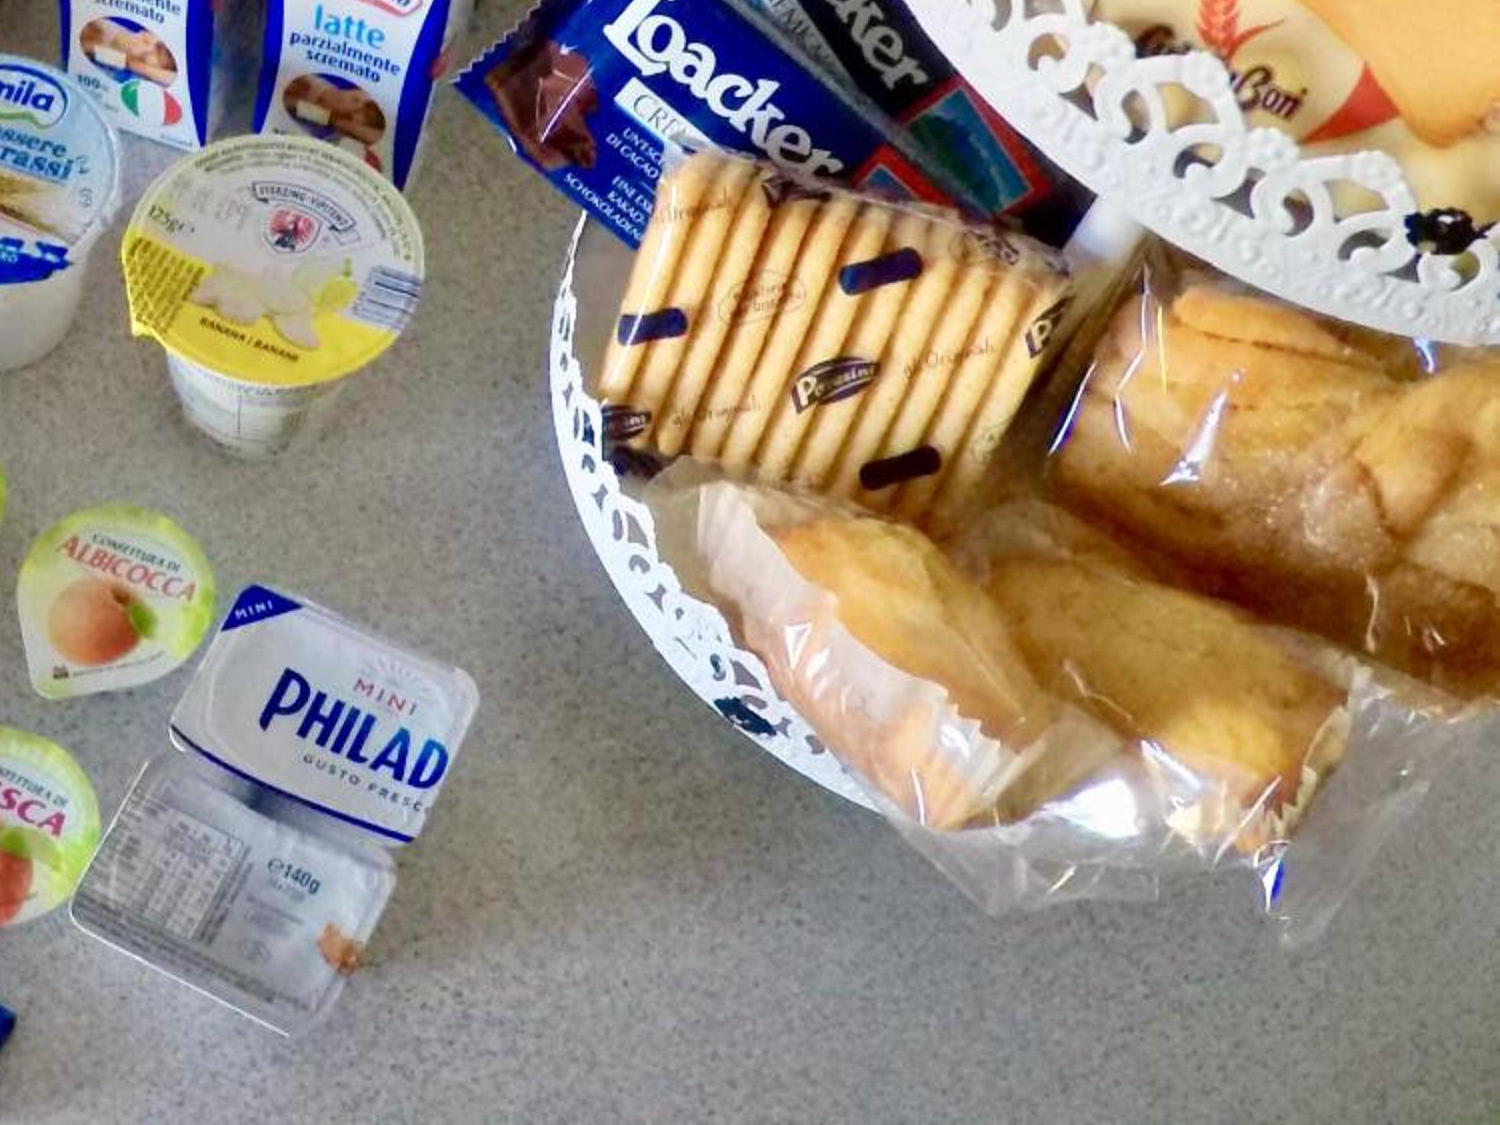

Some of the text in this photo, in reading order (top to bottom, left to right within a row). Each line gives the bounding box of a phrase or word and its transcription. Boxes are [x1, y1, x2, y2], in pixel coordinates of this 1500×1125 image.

[313, 2, 386, 49] latte
[289, 31, 402, 77] parzialmente
[306, 47, 382, 84] scremato
[605, 133, 659, 179] DI CACAO
[198, 316, 246, 344] BANANA
[57, 533, 197, 604] ALBICOCCA
[91, 532, 181, 573] CONFETTURA DI
[233, 597, 276, 621] MINI
[353, 676, 417, 716] MINI
[258, 666, 451, 790] PHILAD
[301, 753, 361, 788] GUSTO
[53, 794, 69, 808] DI
